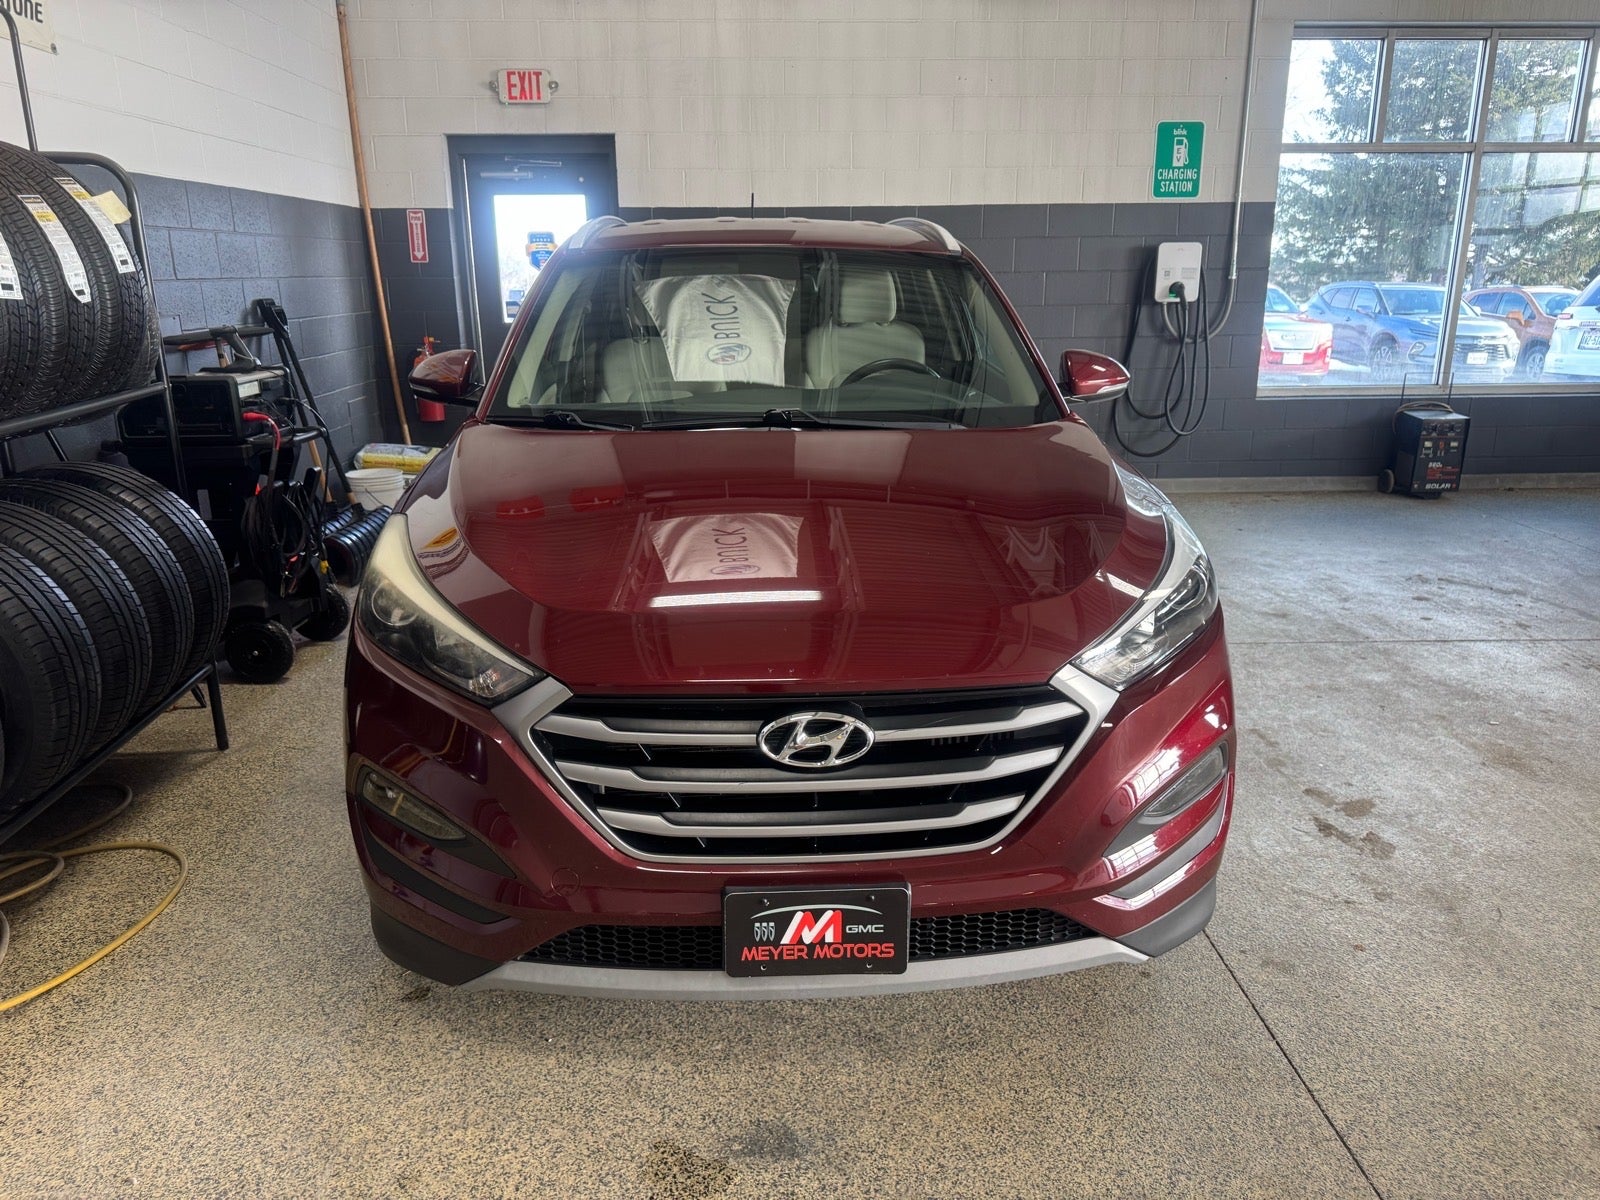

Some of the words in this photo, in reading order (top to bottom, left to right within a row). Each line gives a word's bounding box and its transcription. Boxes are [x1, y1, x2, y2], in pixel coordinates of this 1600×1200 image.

[506, 71, 542, 100] EXIT
[1157, 169, 1198, 180] CHARGING
[1160, 181, 1193, 193] STATION
[846, 924, 884, 934] GMC
[741, 945, 808, 961] MEYER
[814, 943, 894, 959] MOTORS
